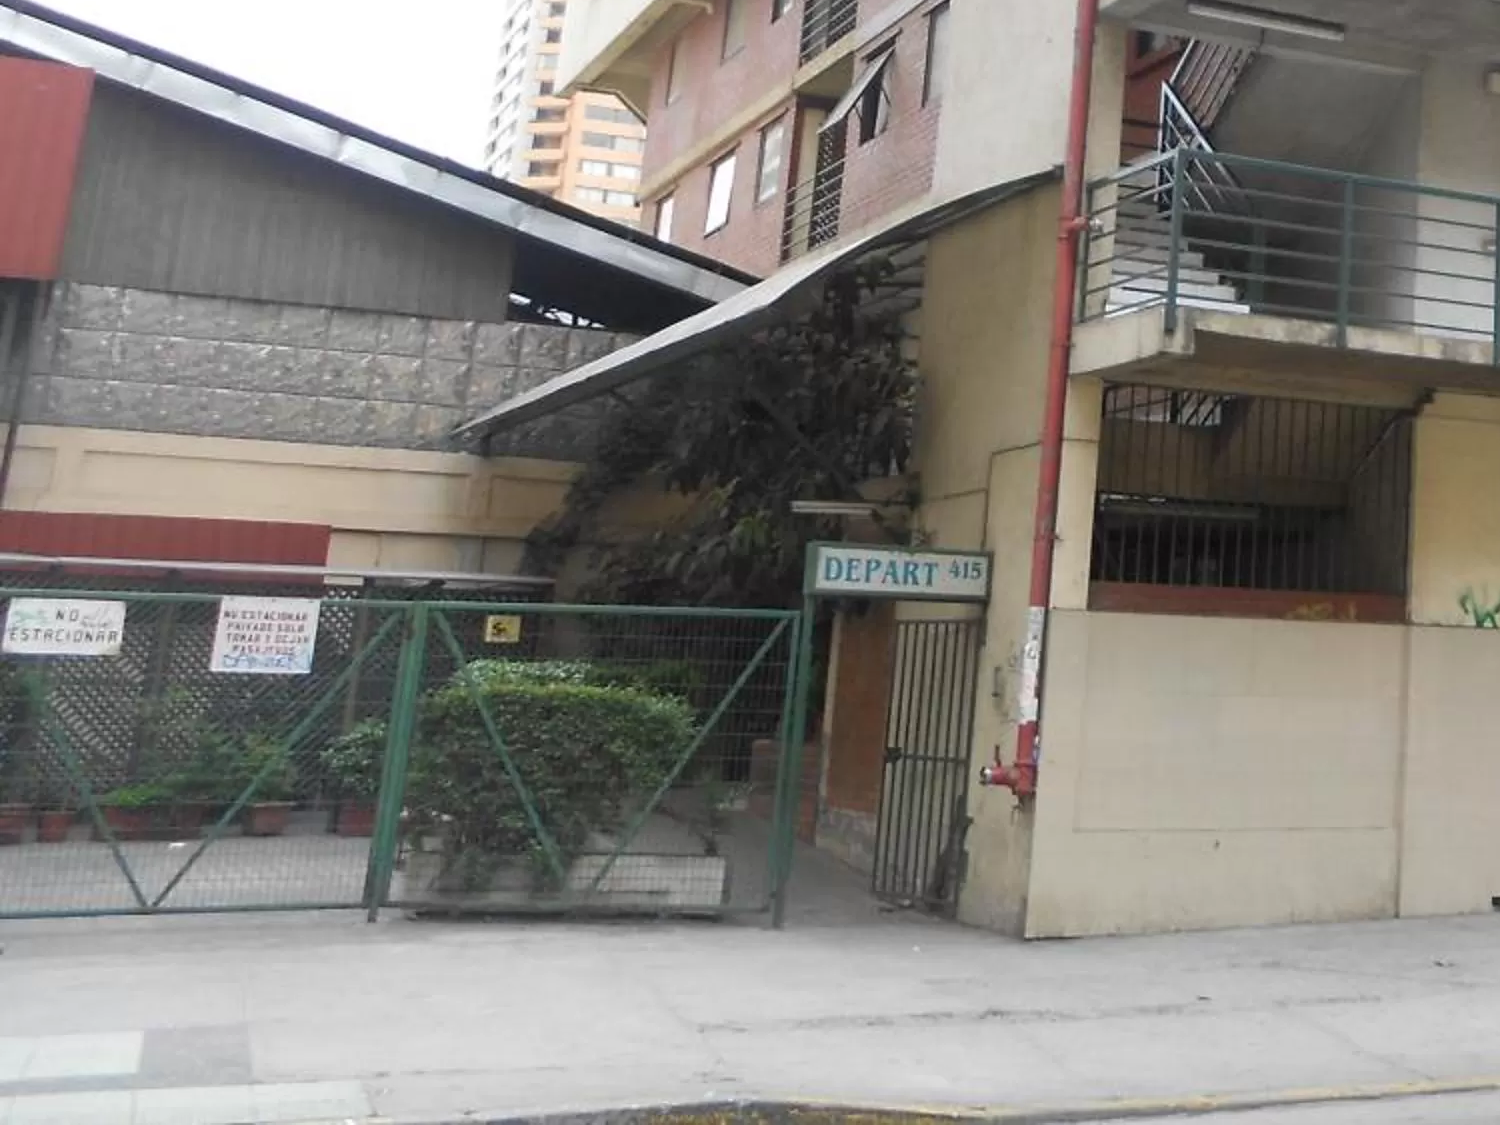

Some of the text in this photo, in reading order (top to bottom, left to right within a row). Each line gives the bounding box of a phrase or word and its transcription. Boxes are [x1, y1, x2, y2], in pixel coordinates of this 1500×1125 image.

[824, 555, 984, 587] DEPART 415
[56, 608, 80, 622] NO
[223, 610, 308, 621] NO ESTACIONAR
[9, 627, 119, 643] ESTACIONAR
